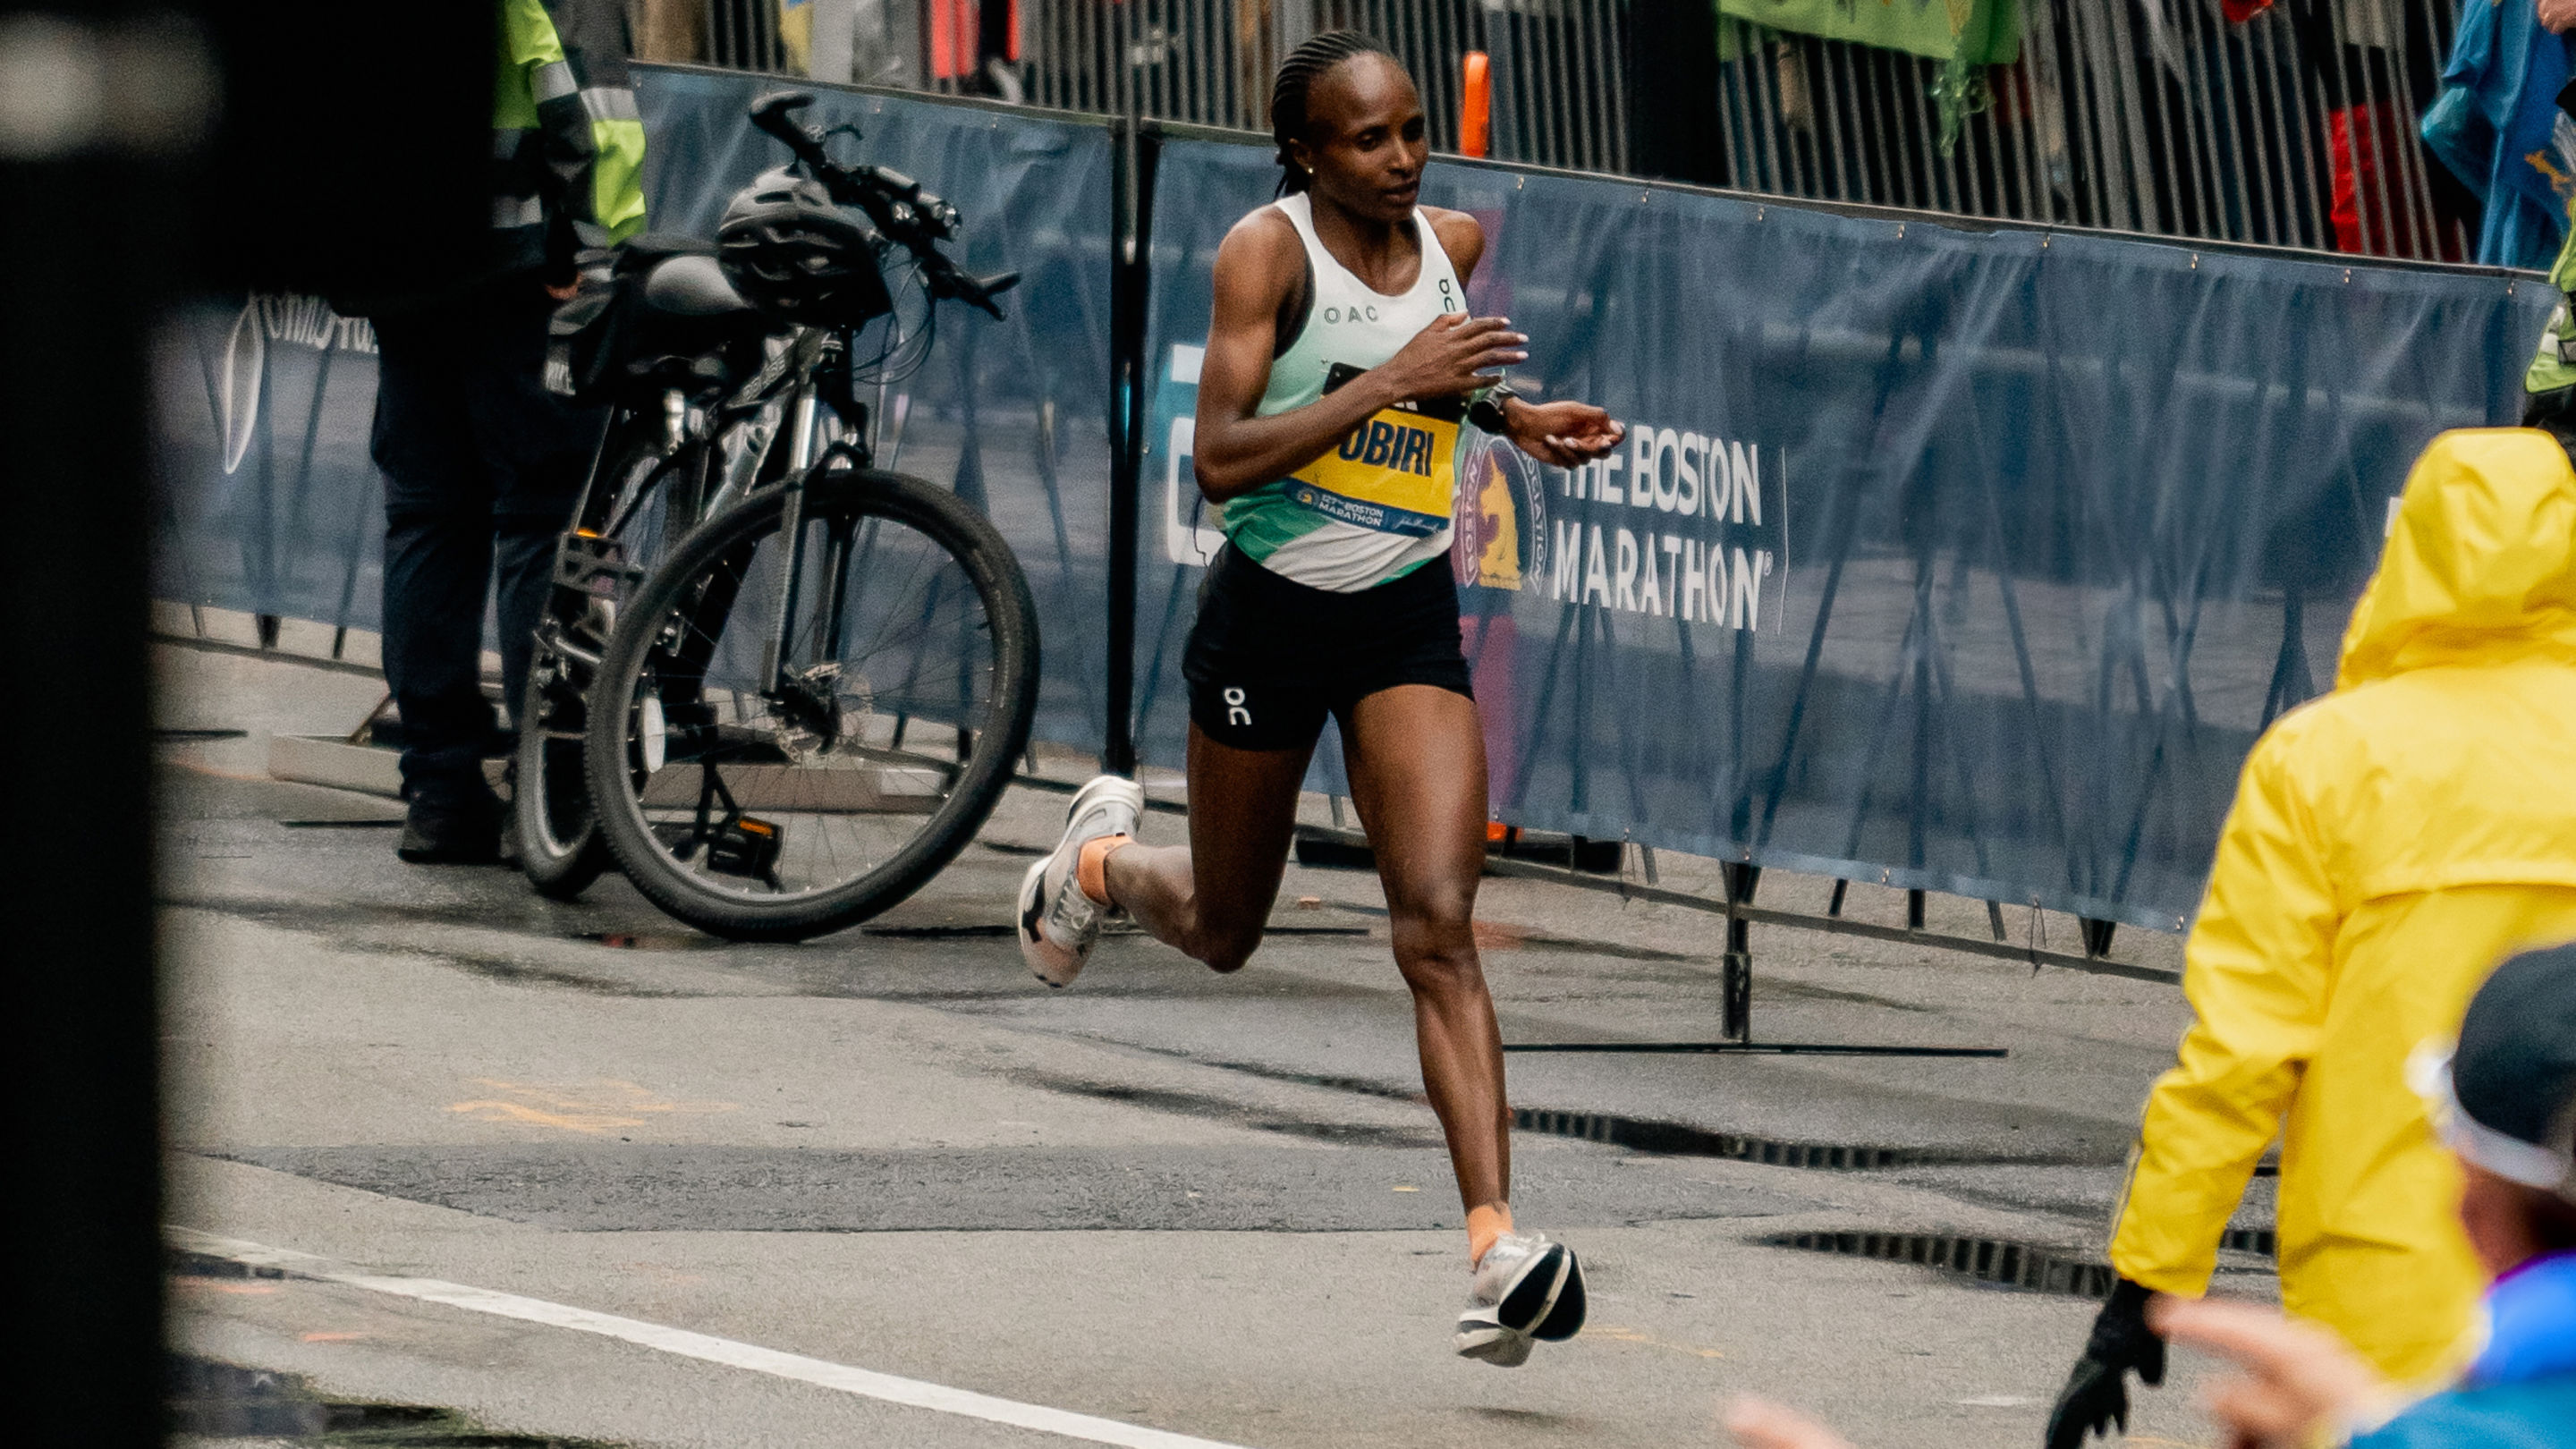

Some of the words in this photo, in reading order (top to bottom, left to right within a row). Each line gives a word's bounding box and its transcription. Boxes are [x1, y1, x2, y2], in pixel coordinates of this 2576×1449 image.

[1324, 305, 1378, 325] OAC
[1339, 419, 1434, 478] OBIRI
[1631, 424, 1762, 526] BOSTON
[1318, 501, 1383, 527] MARATHON
[1344, 502, 1384, 518] BOSTON
[1521, 451, 1546, 581] OCIATION
